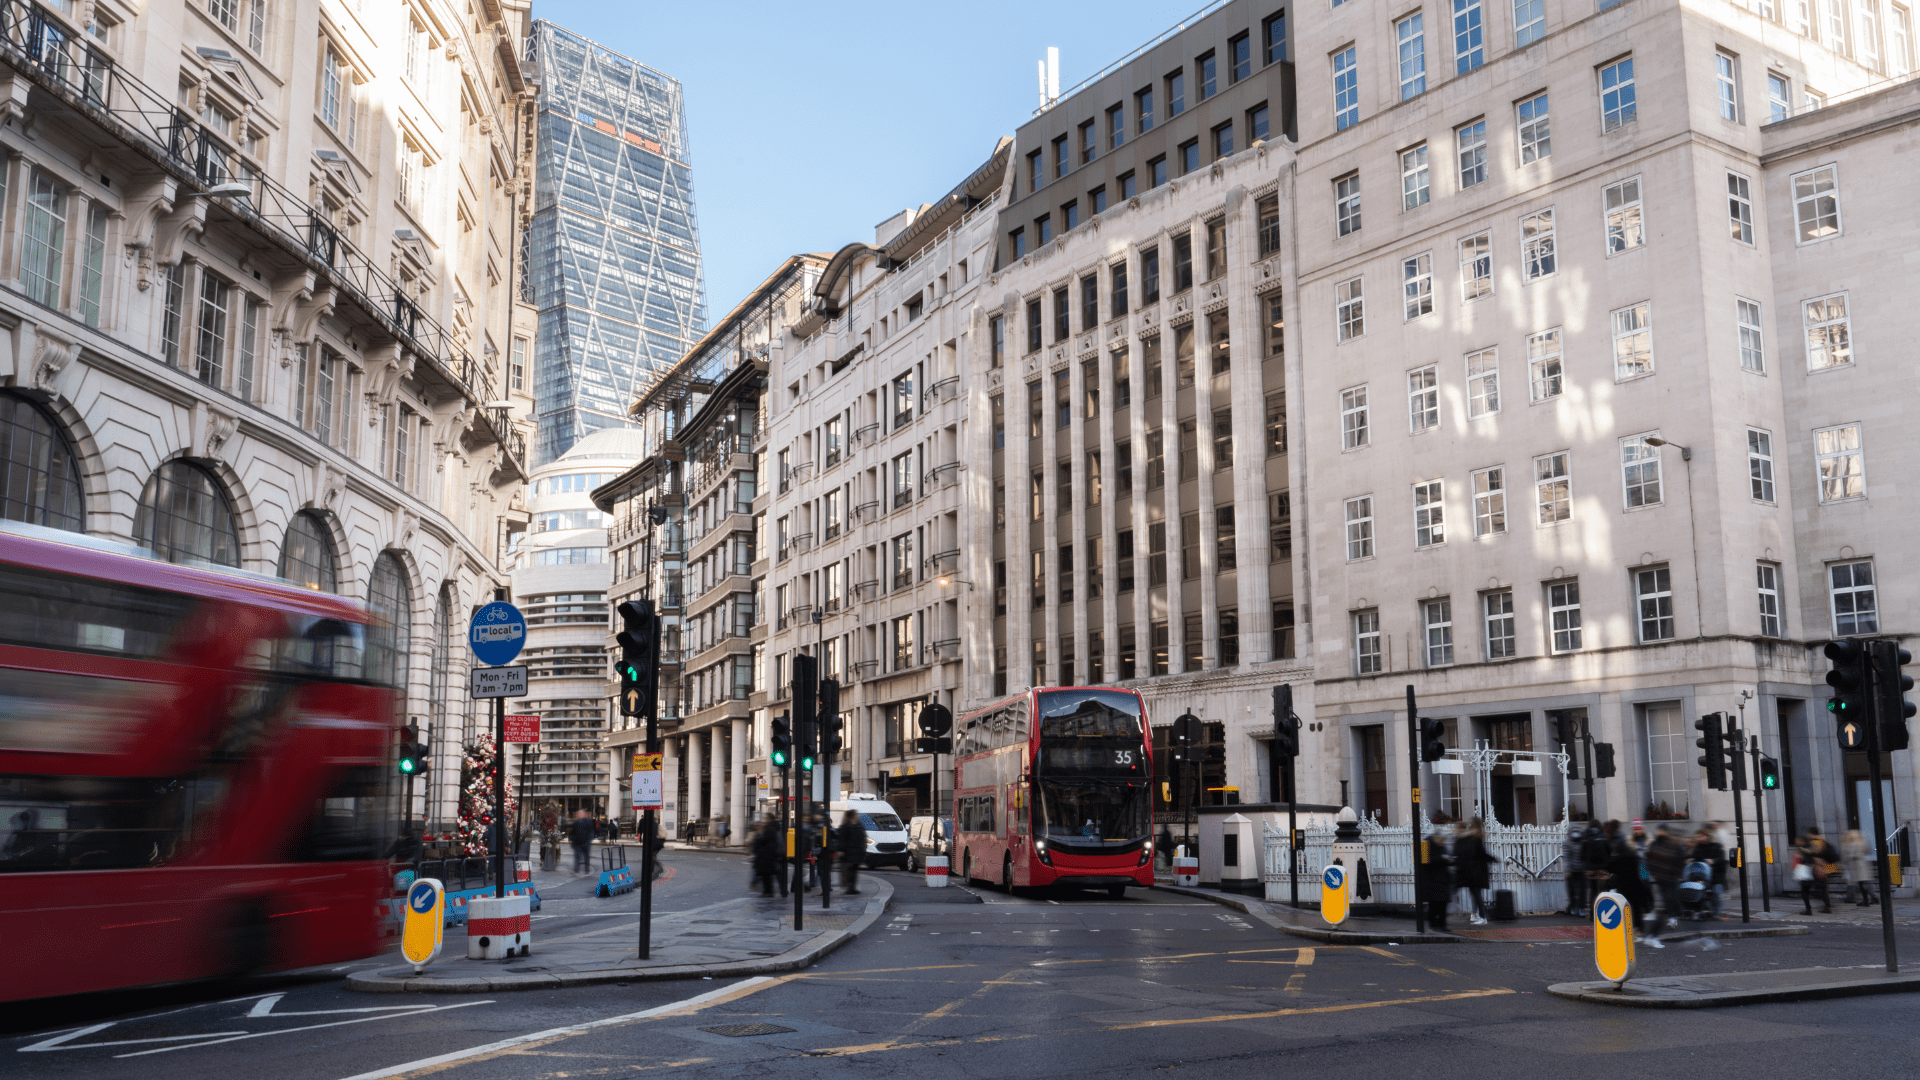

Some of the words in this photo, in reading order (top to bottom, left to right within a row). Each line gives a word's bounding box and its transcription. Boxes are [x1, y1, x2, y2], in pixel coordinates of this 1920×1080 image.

[490, 626, 512, 635] local
[480, 673, 500, 682] Mon
[507, 671, 518, 680] Fri
[1115, 750, 1131, 764] 35
